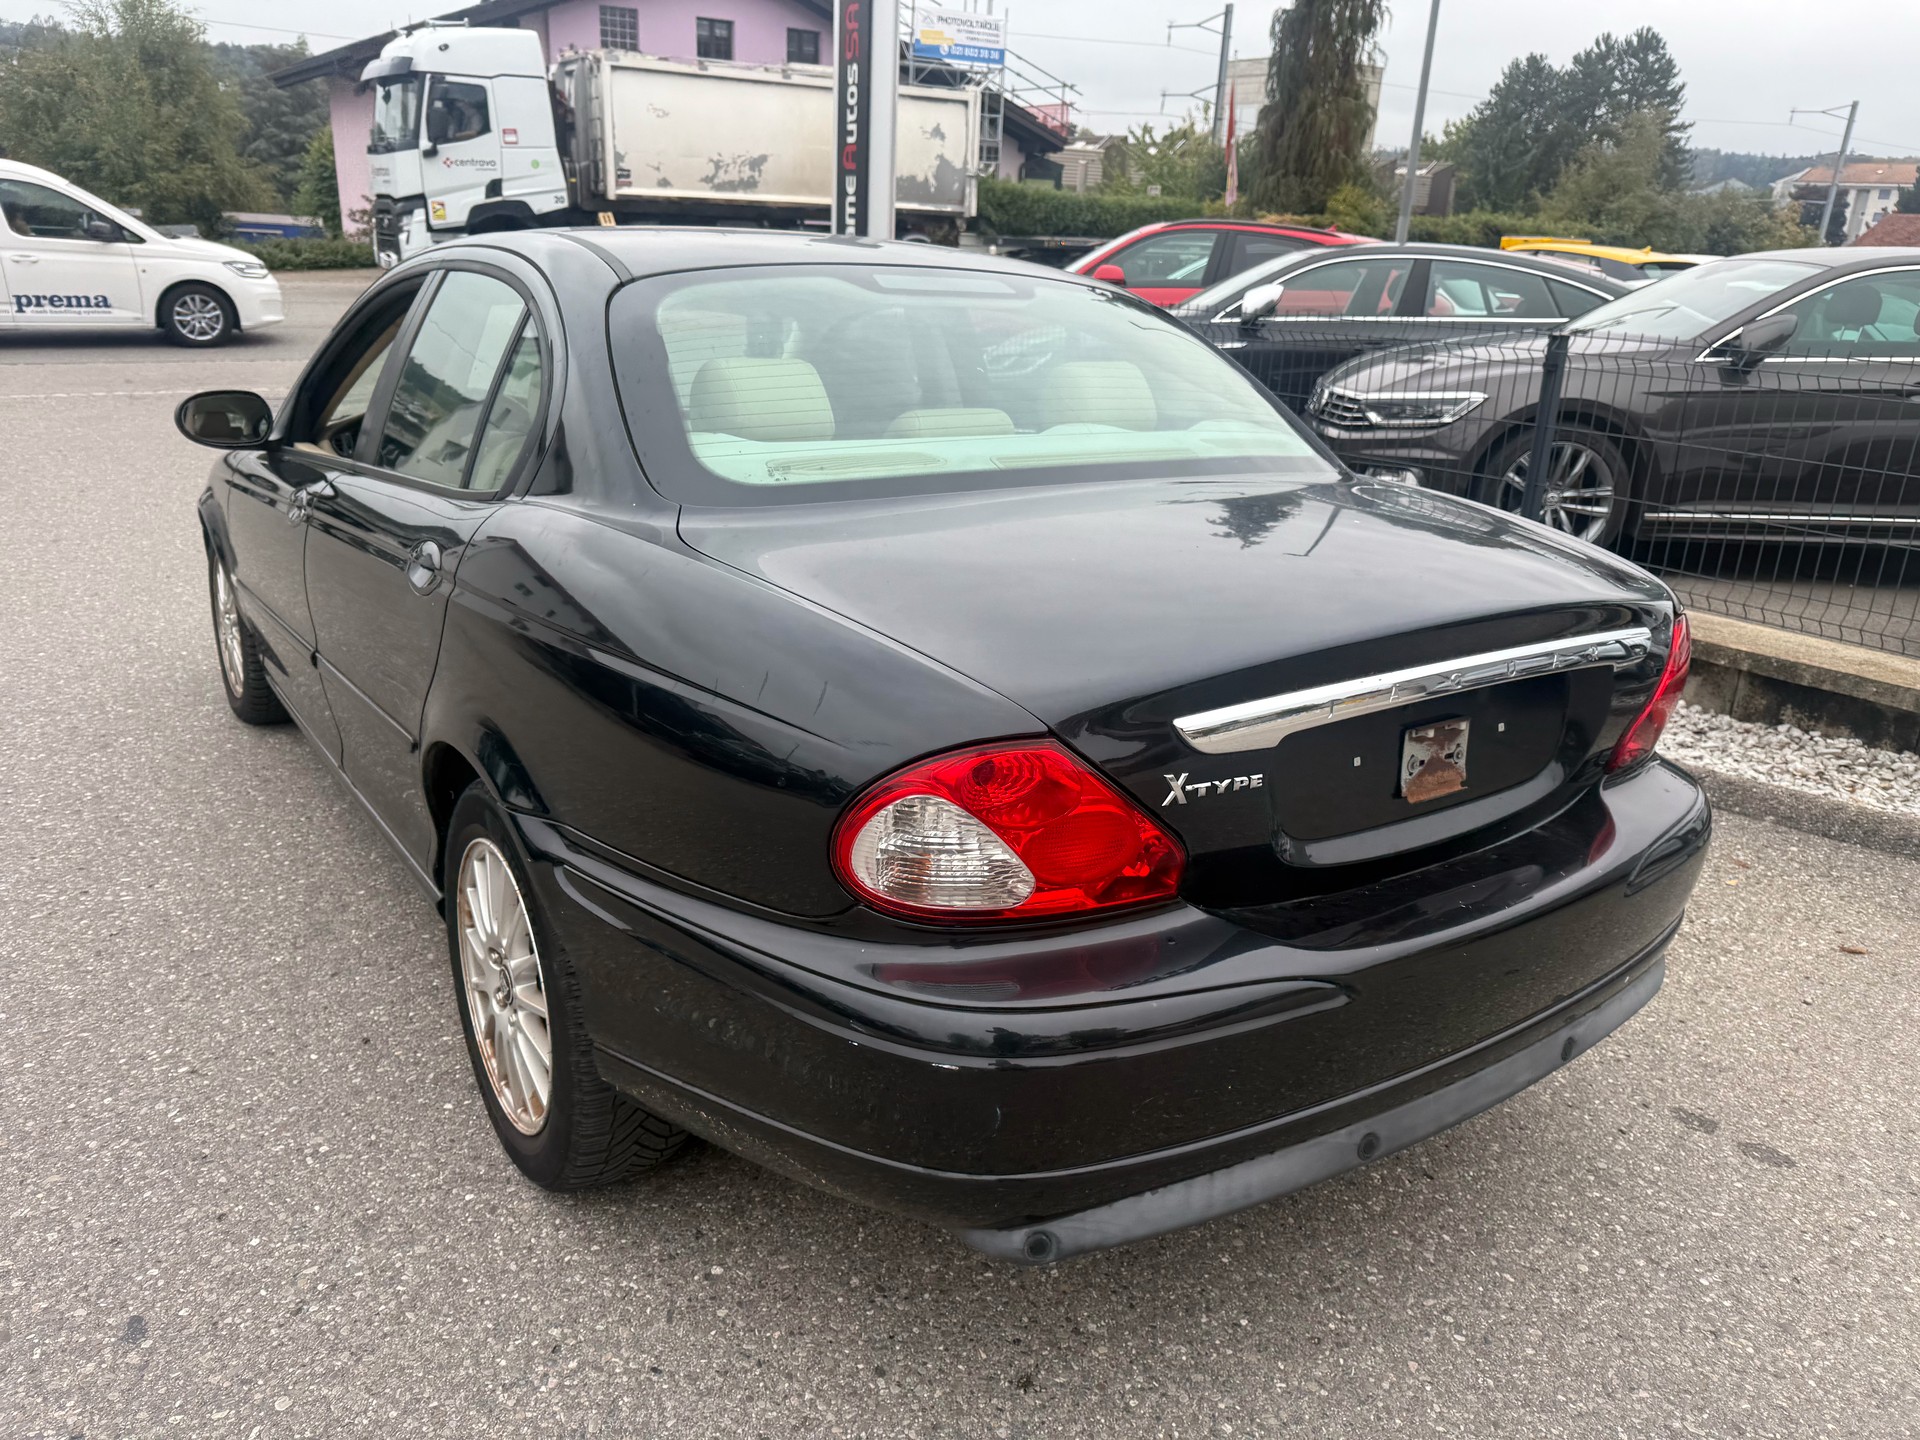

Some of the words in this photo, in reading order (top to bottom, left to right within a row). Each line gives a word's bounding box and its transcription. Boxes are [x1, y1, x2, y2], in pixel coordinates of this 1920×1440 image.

[845, 2, 860, 60] SA
[843, 62, 859, 170] Autos
[12, 294, 112, 314] prema
[1161, 772, 1264, 807] X-TYPE
